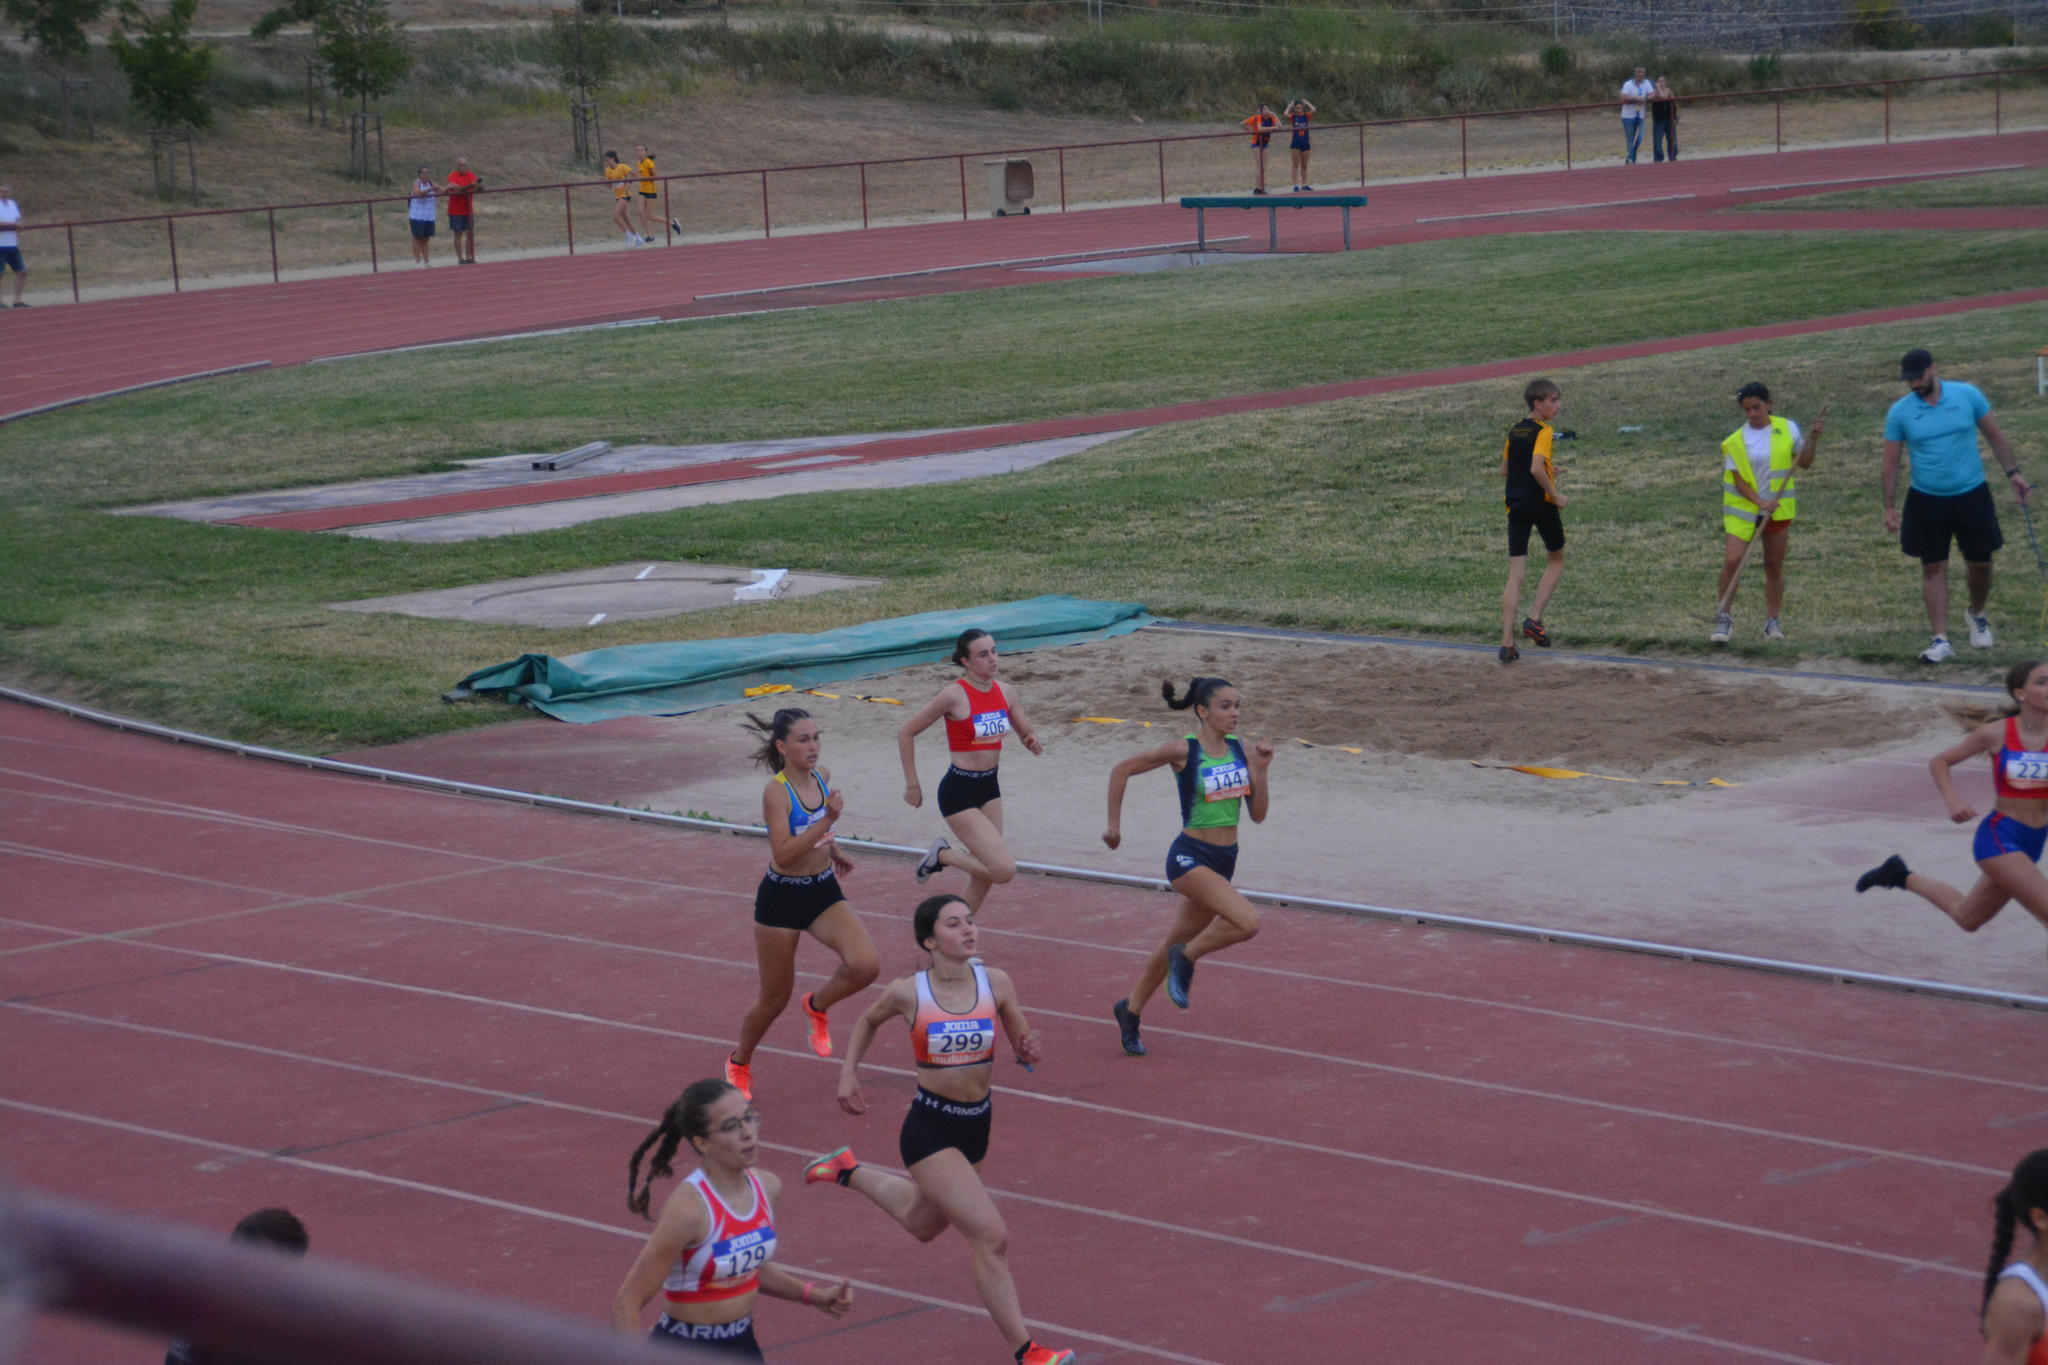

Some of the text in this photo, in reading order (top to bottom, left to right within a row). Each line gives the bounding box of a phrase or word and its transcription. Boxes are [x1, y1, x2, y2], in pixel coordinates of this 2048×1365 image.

[981, 719, 1005, 736] 206
[1213, 771, 1243, 791] 144
[780, 876, 812, 885] PRO
[940, 1032, 983, 1053] 299
[727, 1245, 766, 1278] 129
